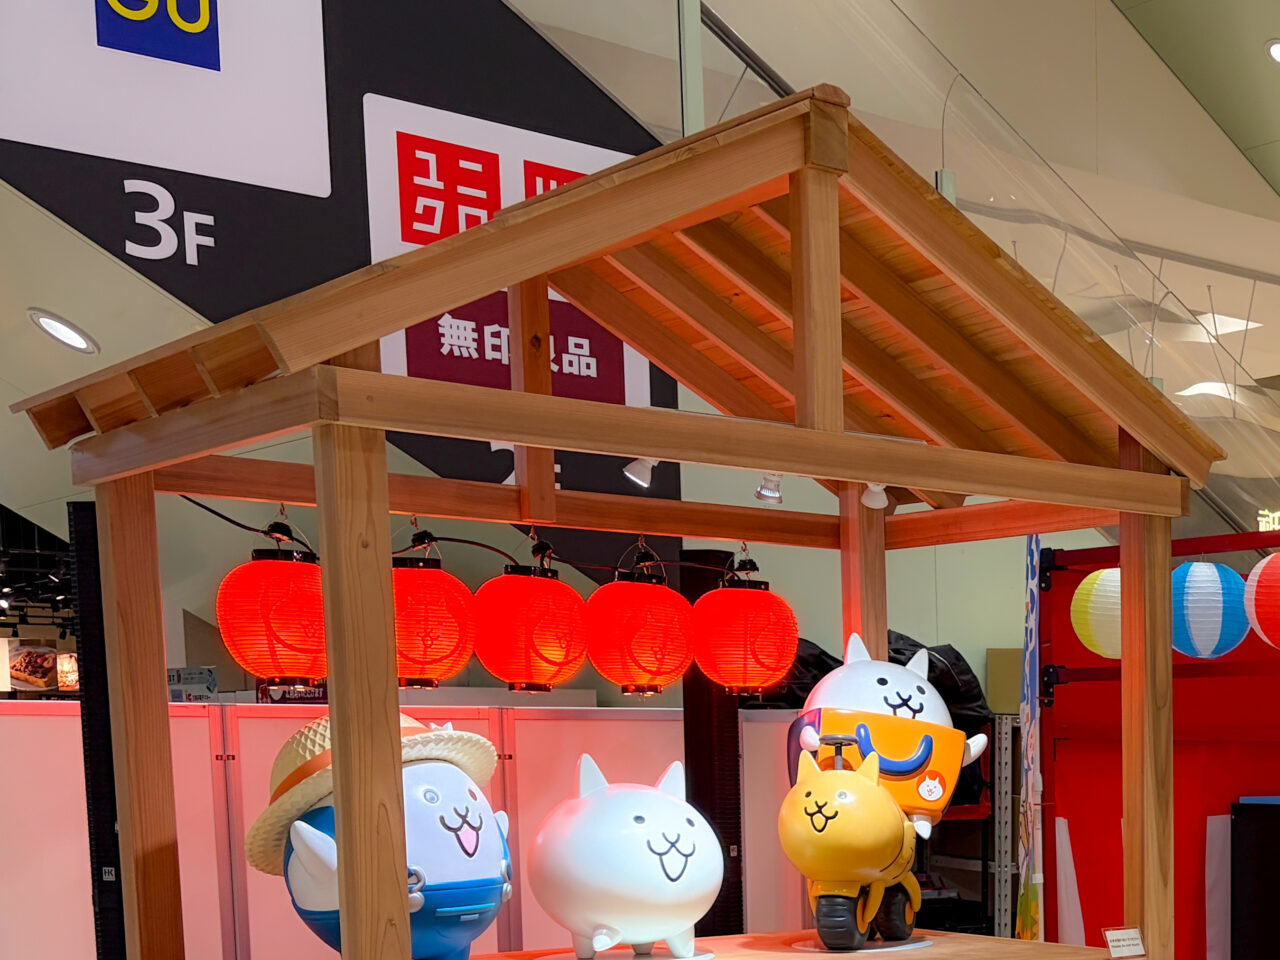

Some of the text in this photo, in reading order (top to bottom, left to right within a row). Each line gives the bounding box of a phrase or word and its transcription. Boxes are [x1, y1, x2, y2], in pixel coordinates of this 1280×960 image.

[123, 179, 216, 266] 3F
[437, 312, 598, 379] 無印品
